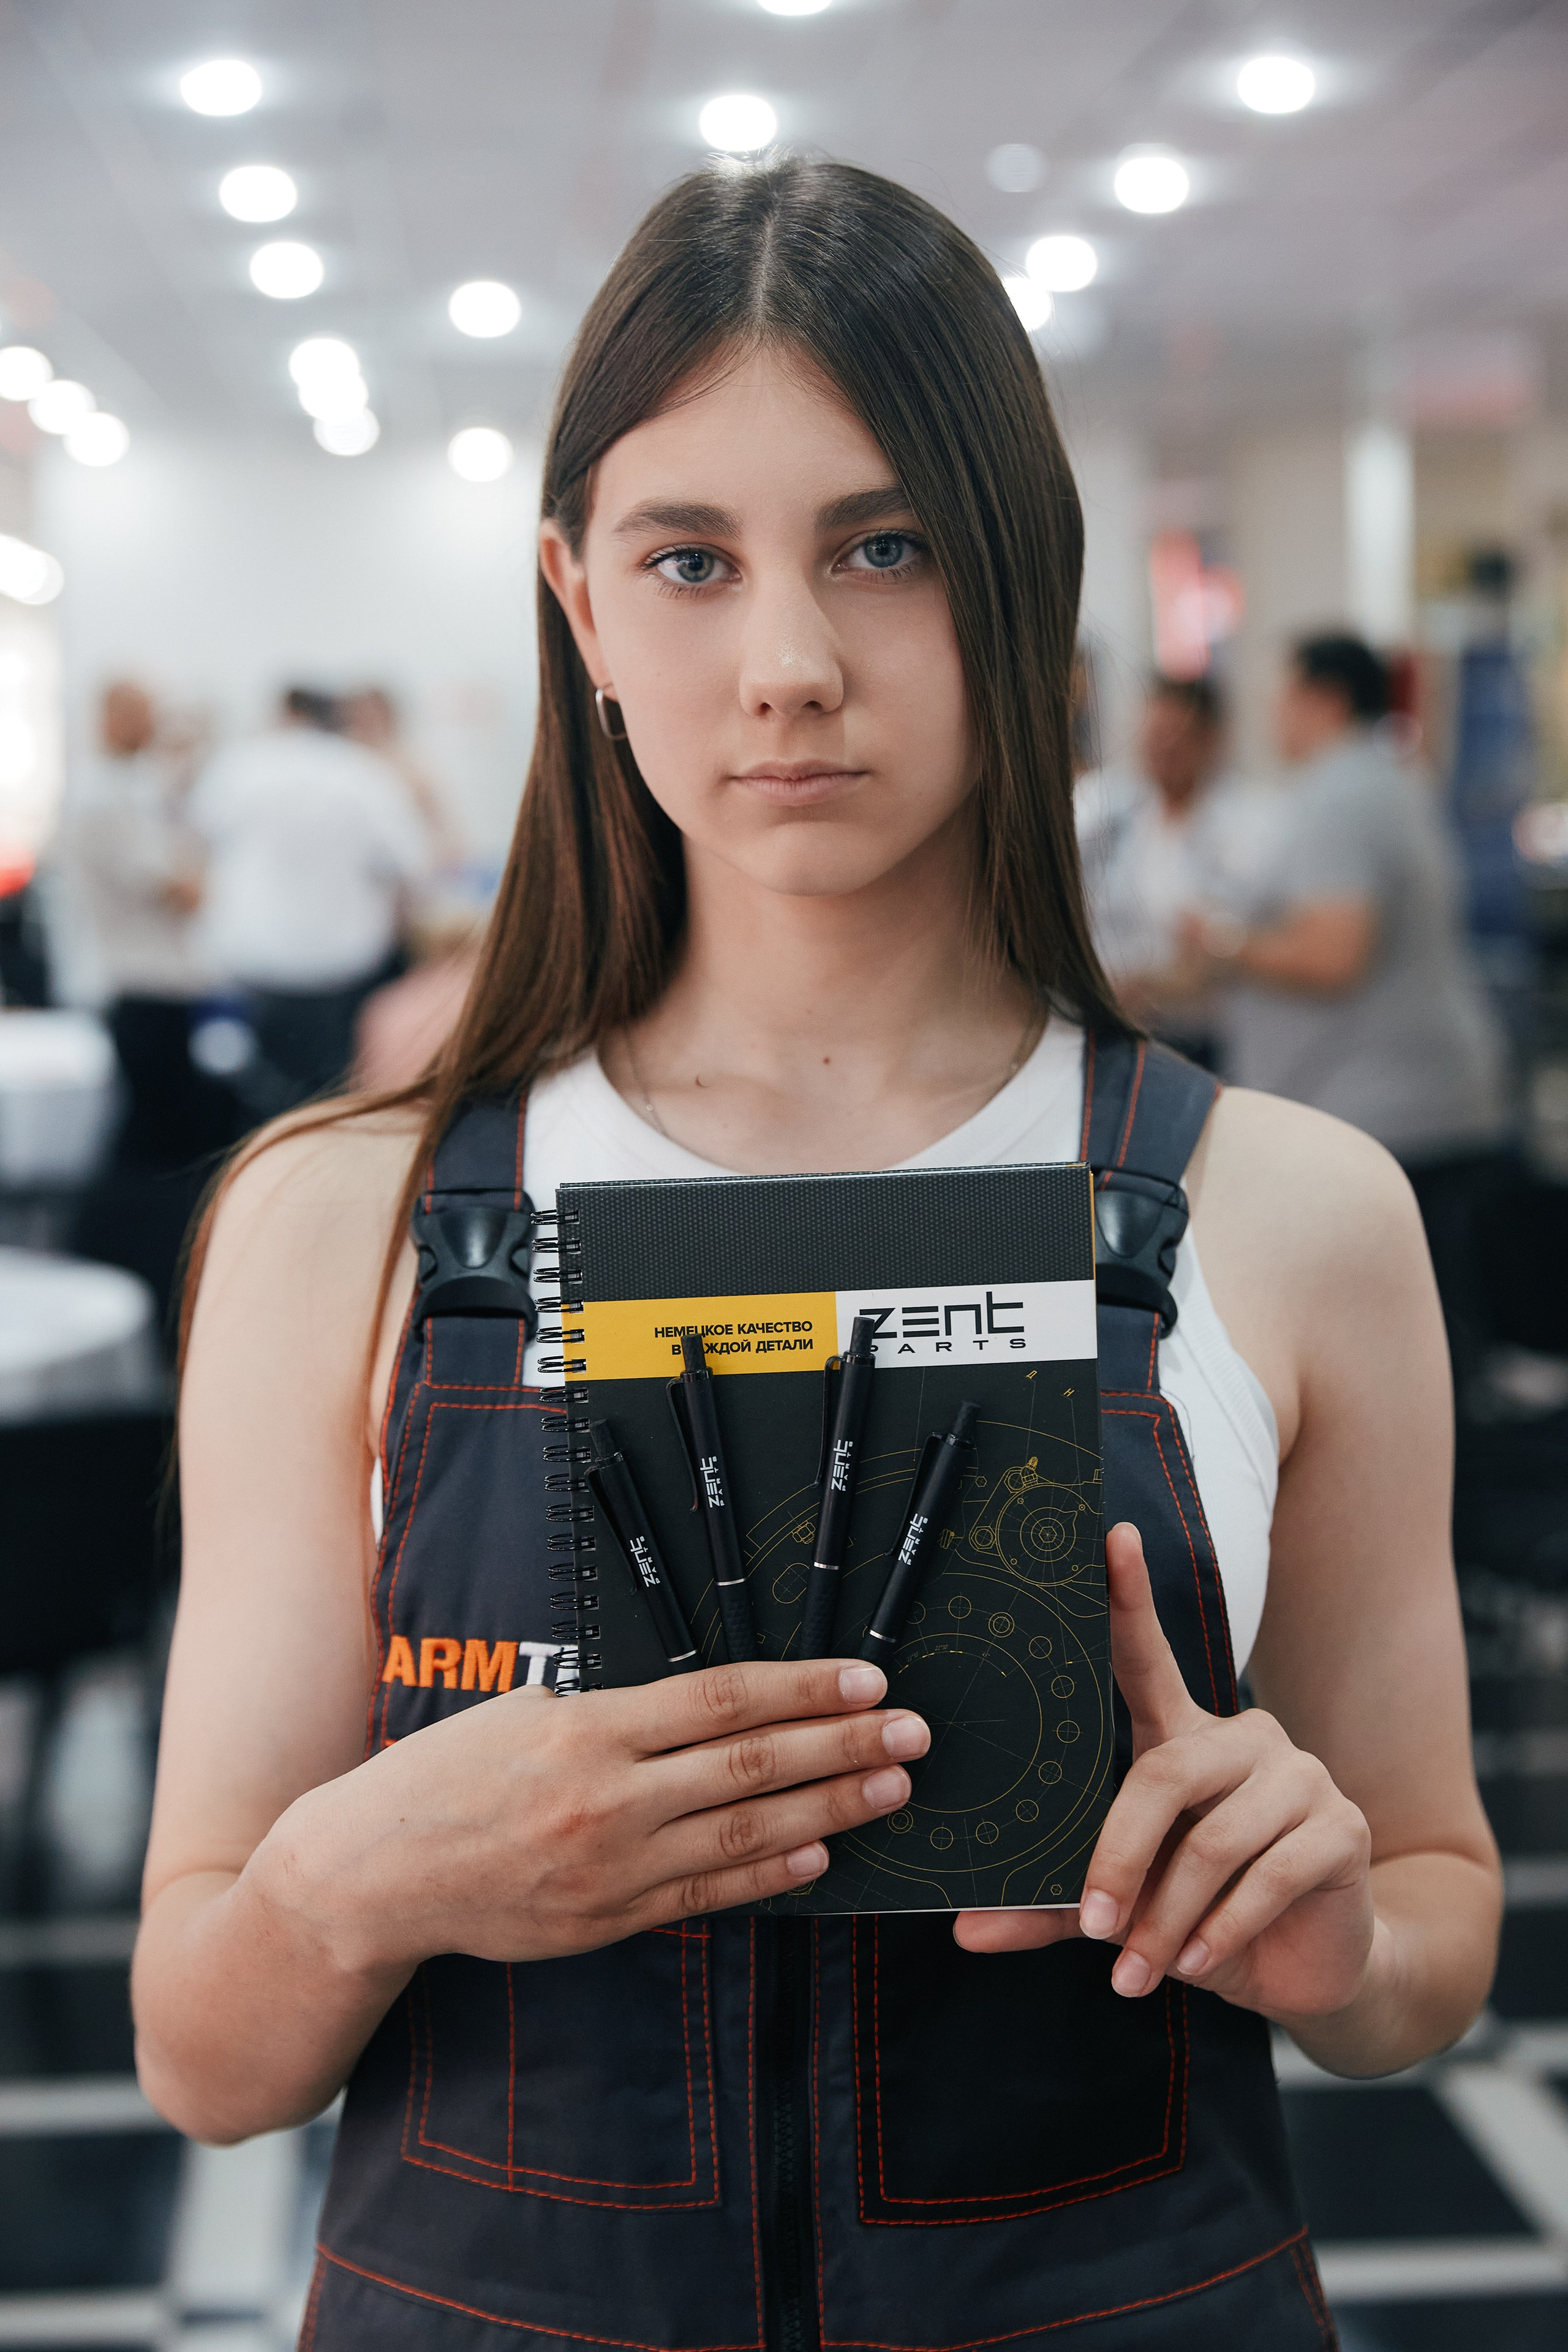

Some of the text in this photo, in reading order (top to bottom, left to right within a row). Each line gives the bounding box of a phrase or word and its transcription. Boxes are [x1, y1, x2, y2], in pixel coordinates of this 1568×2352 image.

[655, 1321, 813, 1338] НЕМЕЦКОЕ КАЧЕСТВО
[672, 1339, 813, 1355] В ЖДОЙ ДЕТАЛИ
[842, 1441, 853, 1491] PARTS
